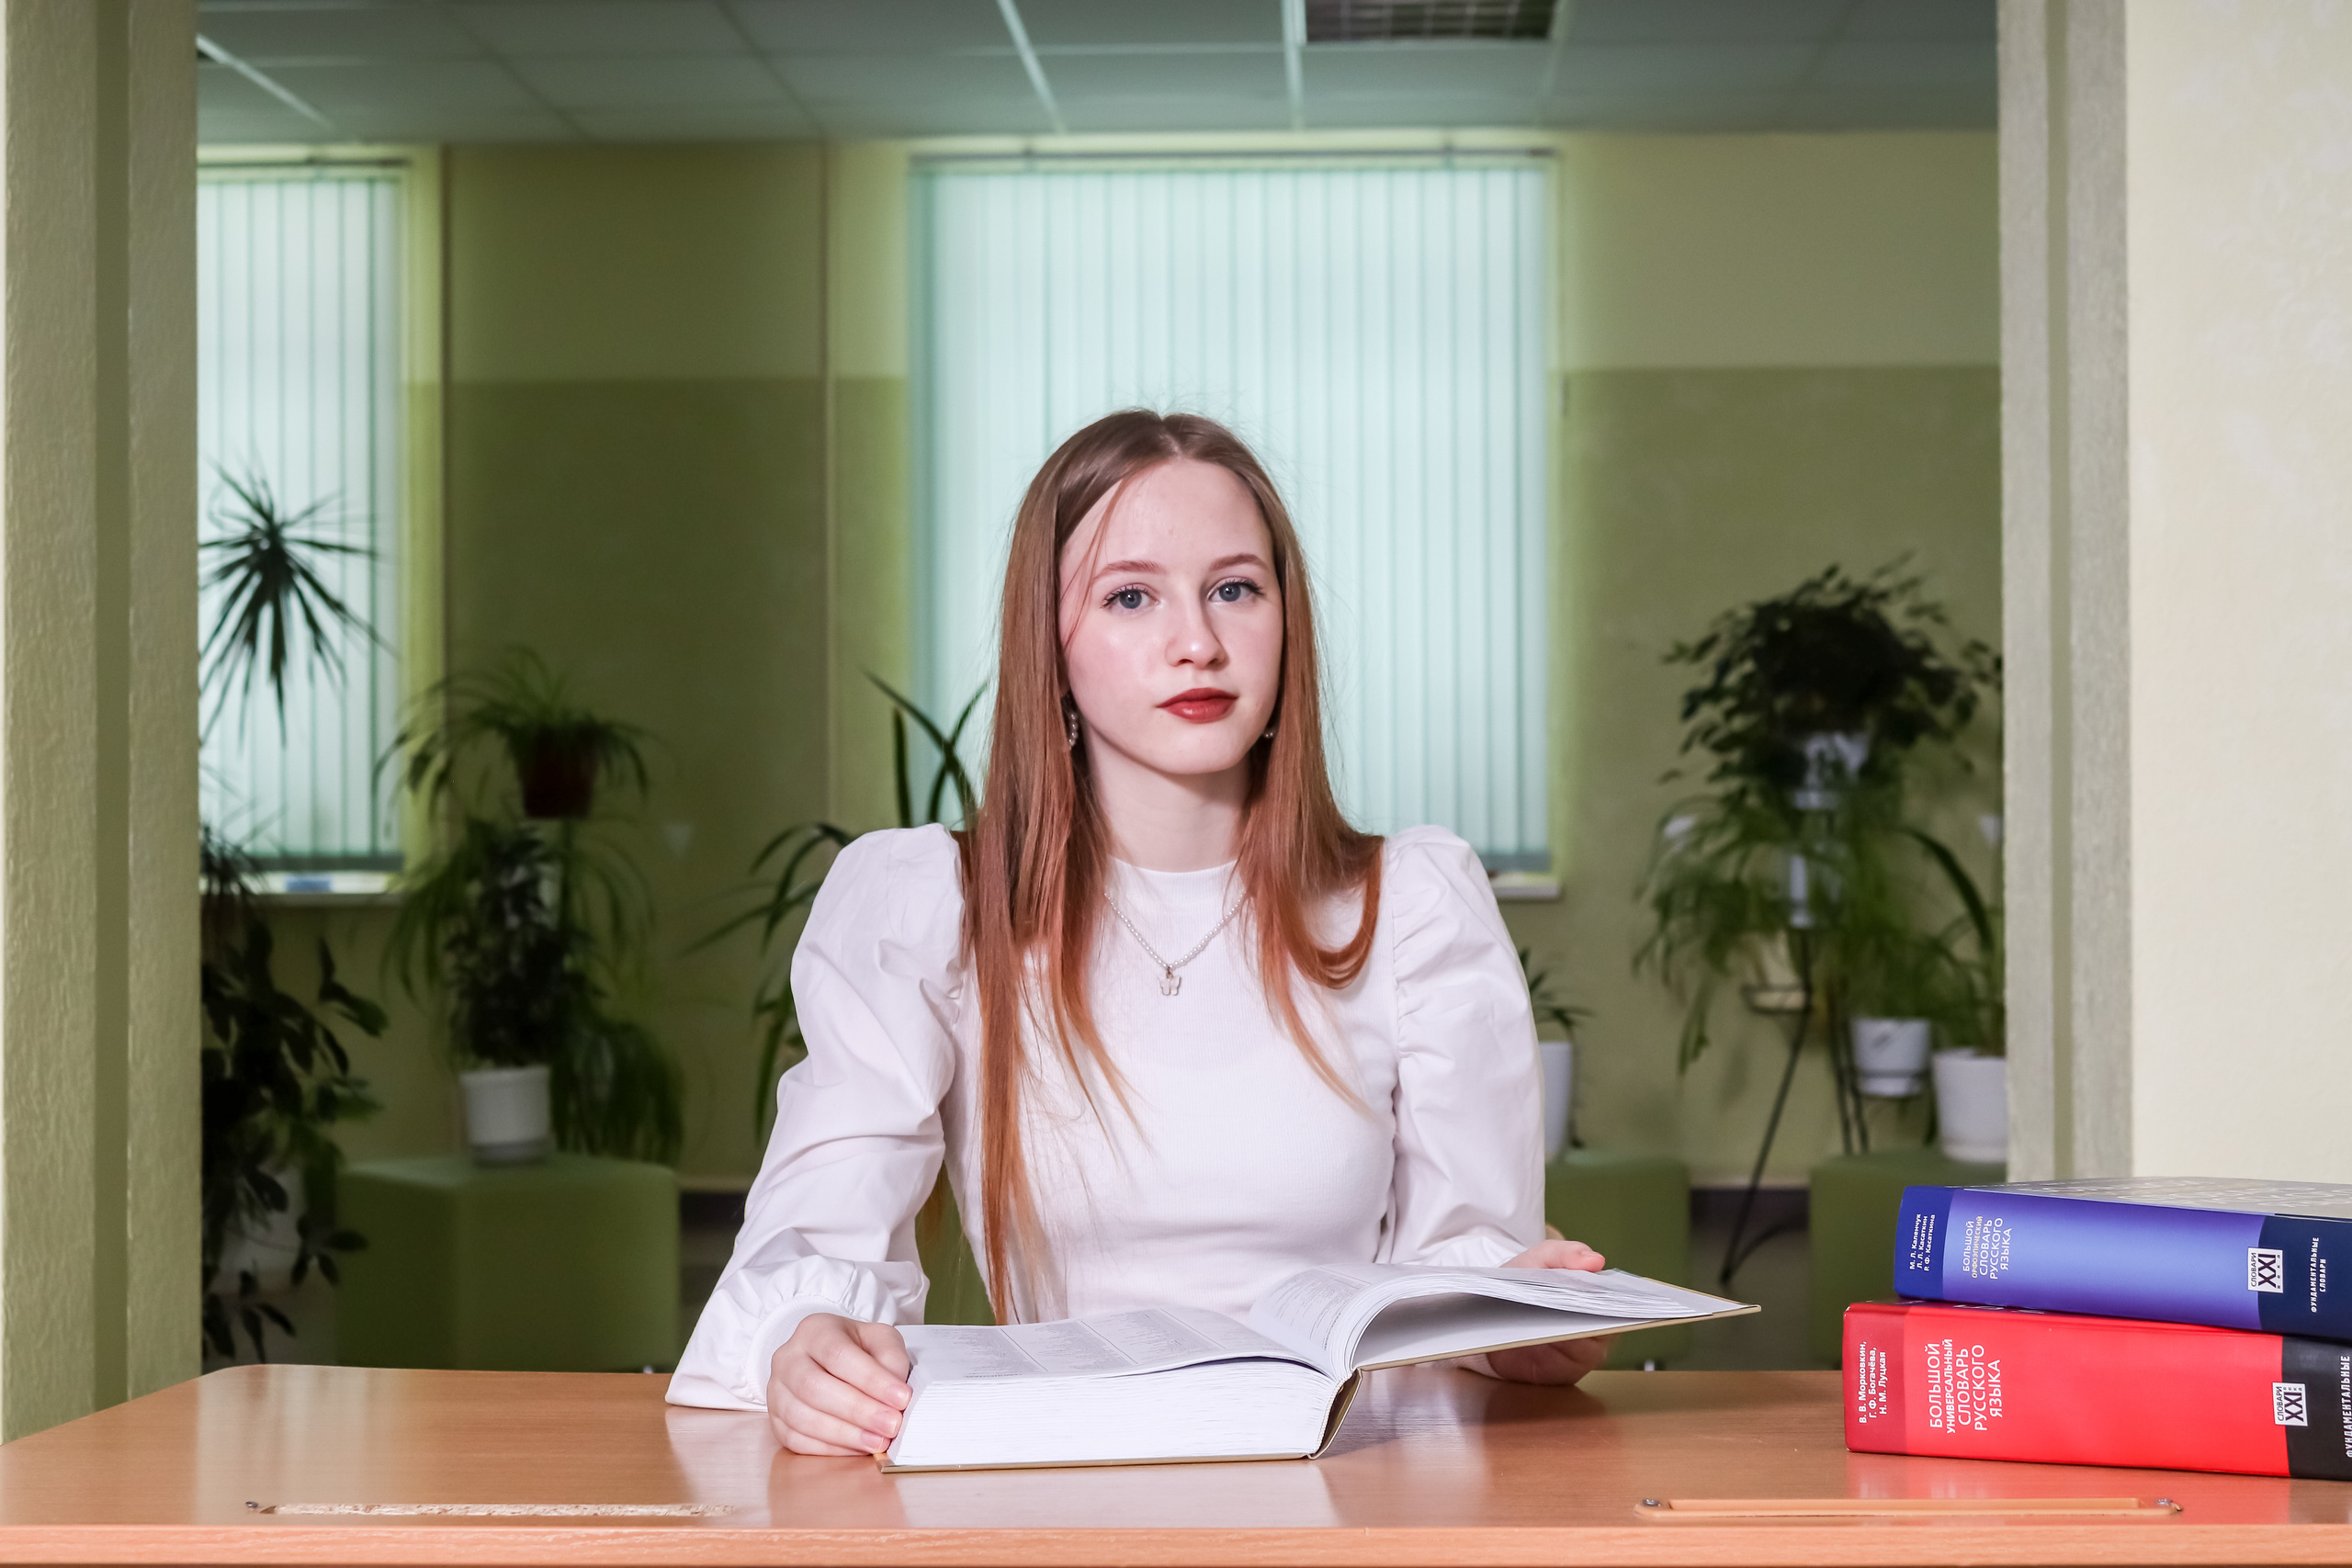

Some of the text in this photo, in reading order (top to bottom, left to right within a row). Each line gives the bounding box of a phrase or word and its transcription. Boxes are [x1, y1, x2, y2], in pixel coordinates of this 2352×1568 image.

[1911, 1213, 1922, 1249] Каленчук
[1918, 1215, 1928, 1250] Касаткин
[1925, 1214, 1936, 1254] Касаткина
[1962, 1221, 1974, 1271] БОЛЬШОЙ
[1972, 1215, 1984, 1279] ОРФОЭПИЧЕСКИЙ
[1979, 1219, 1993, 1276] СЛОВАРЬ
[1989, 1217, 2003, 1280] РУССКОГО
[2000, 1227, 2012, 1270] ЯЗЫКА
[1909, 1260, 1916, 1269] М.
[2257, 1253, 2277, 1289] XXI
[2310, 1236, 2320, 1313] ФУНДАМЕНТАЛЬНЫЕ
[1858, 1341, 1868, 1424] В. В. Морковкин,
[1868, 1347, 1877, 1395] Богачёва,
[1878, 1351, 1888, 1415] Н. М. Луцкая
[1924, 1343, 1943, 1428] БОЛЬШОЙ
[1941, 1338, 1956, 1434] УНИВЕРСАЛЬНЫЙ
[1955, 1348, 1972, 1426] СЛОВАРЬ
[1971, 1344, 1988, 1431] РУССКОГО
[1987, 1359, 2003, 1417] ЯЗЫКА
[1868, 1396, 1877, 1410] Ф.
[2275, 1385, 2285, 1421] СЛОВАРИ
[2283, 1391, 2304, 1423] XXI
